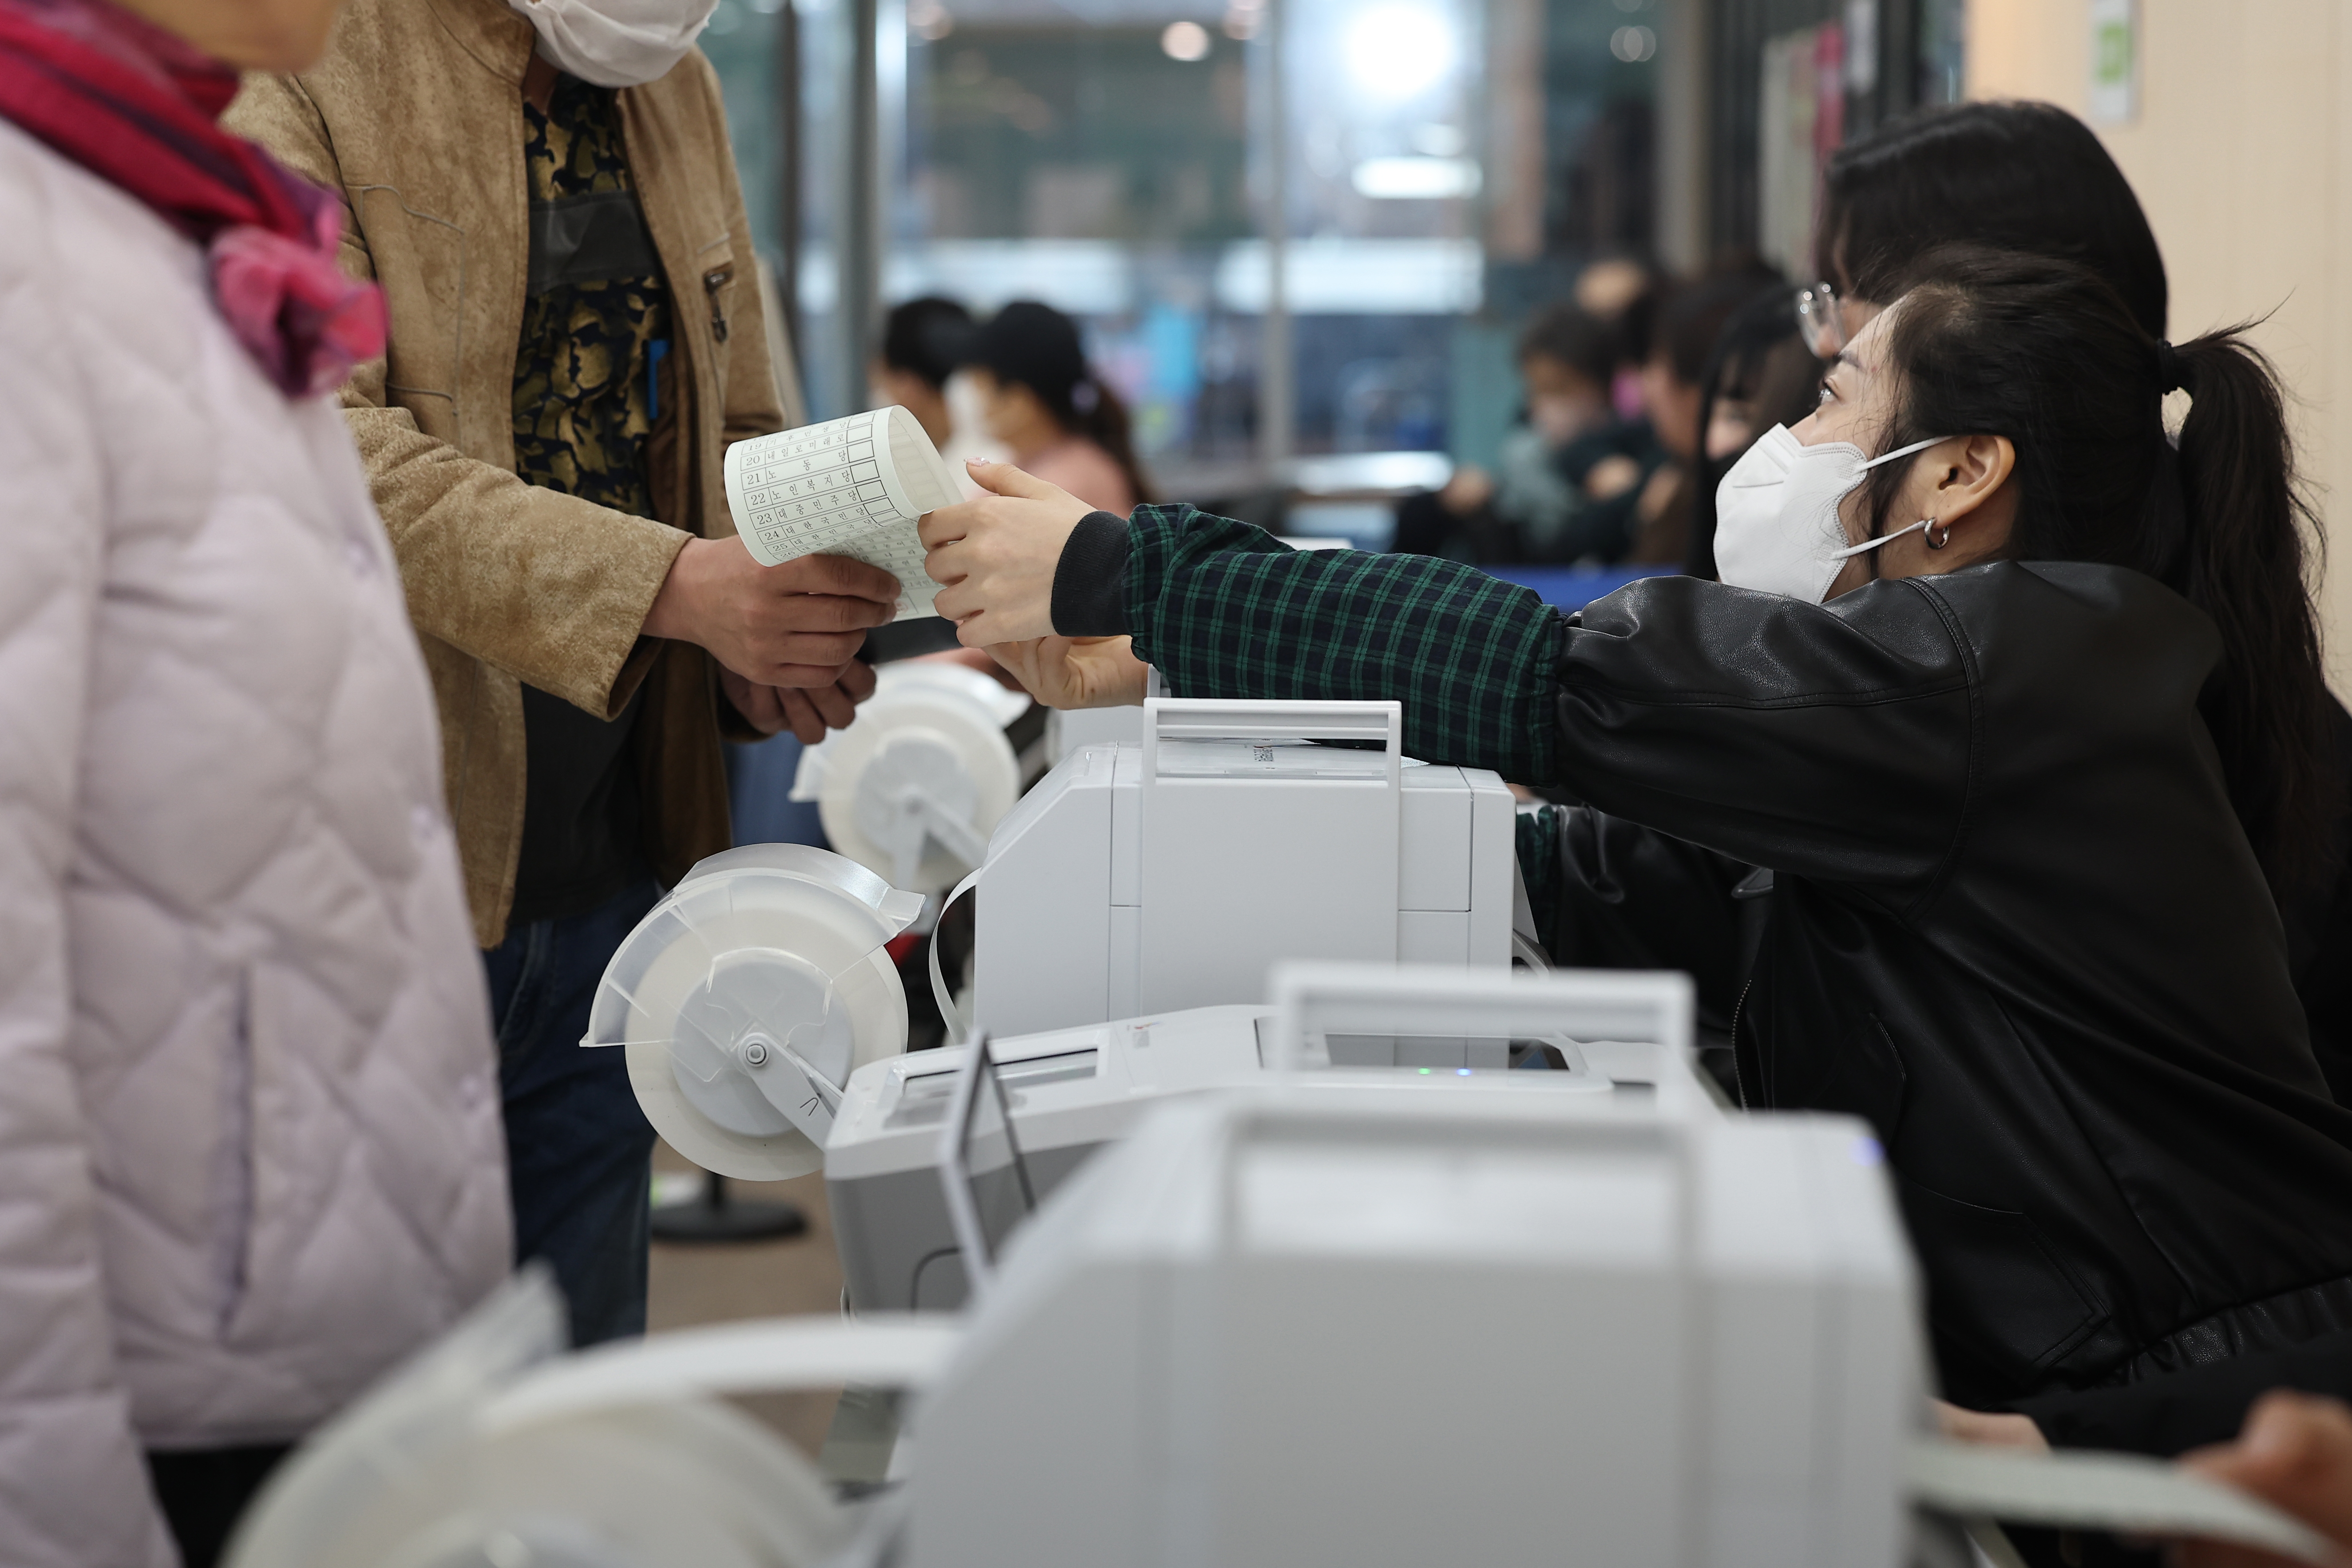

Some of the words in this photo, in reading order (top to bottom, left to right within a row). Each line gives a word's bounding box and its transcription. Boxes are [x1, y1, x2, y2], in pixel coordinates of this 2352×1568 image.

[746, 455, 760, 466] 20
[768, 434, 845, 460] 내일로미래로
[747, 474, 761, 485] 21
[768, 450, 847, 480] 노동당
[751, 493, 766, 506] 22
[772, 470, 850, 500] 노인복지당
[757, 513, 772, 525] 23
[778, 490, 857, 519] 대중민주당
[764, 530, 780, 541] 24
[786, 507, 865, 534] 대한국민당
[772, 543, 788, 552] 25
[794, 517, 872, 545] 대한민국당
